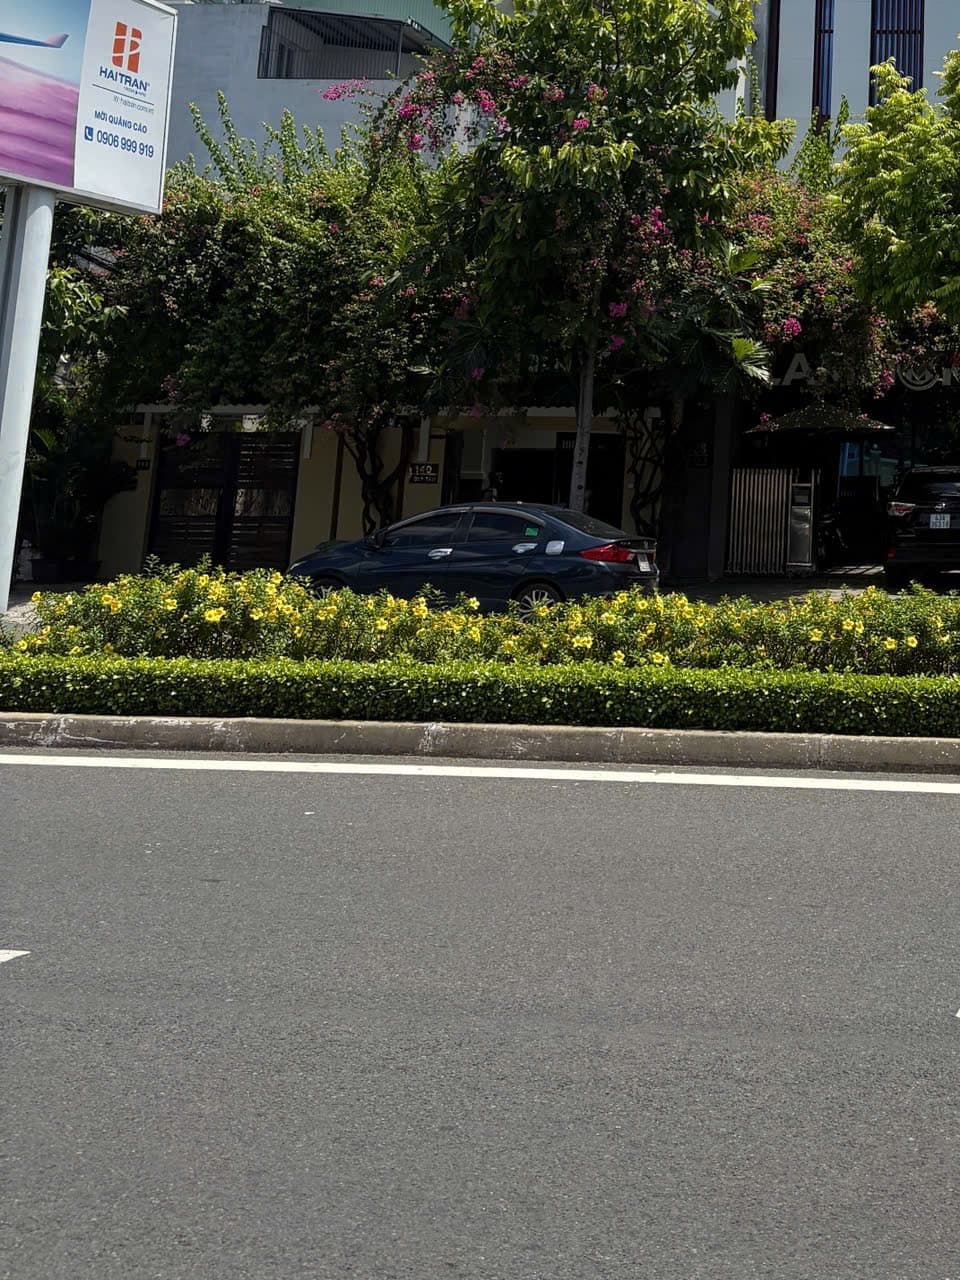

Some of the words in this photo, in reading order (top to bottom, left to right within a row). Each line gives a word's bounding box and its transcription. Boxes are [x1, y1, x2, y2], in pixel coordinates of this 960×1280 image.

[94, 110, 107, 122] MỜI
[133, 121, 148, 134] CÁO
[97, 130, 119, 148] 0906
[120, 136, 137, 153] 999
[138, 142, 154, 158] 919
